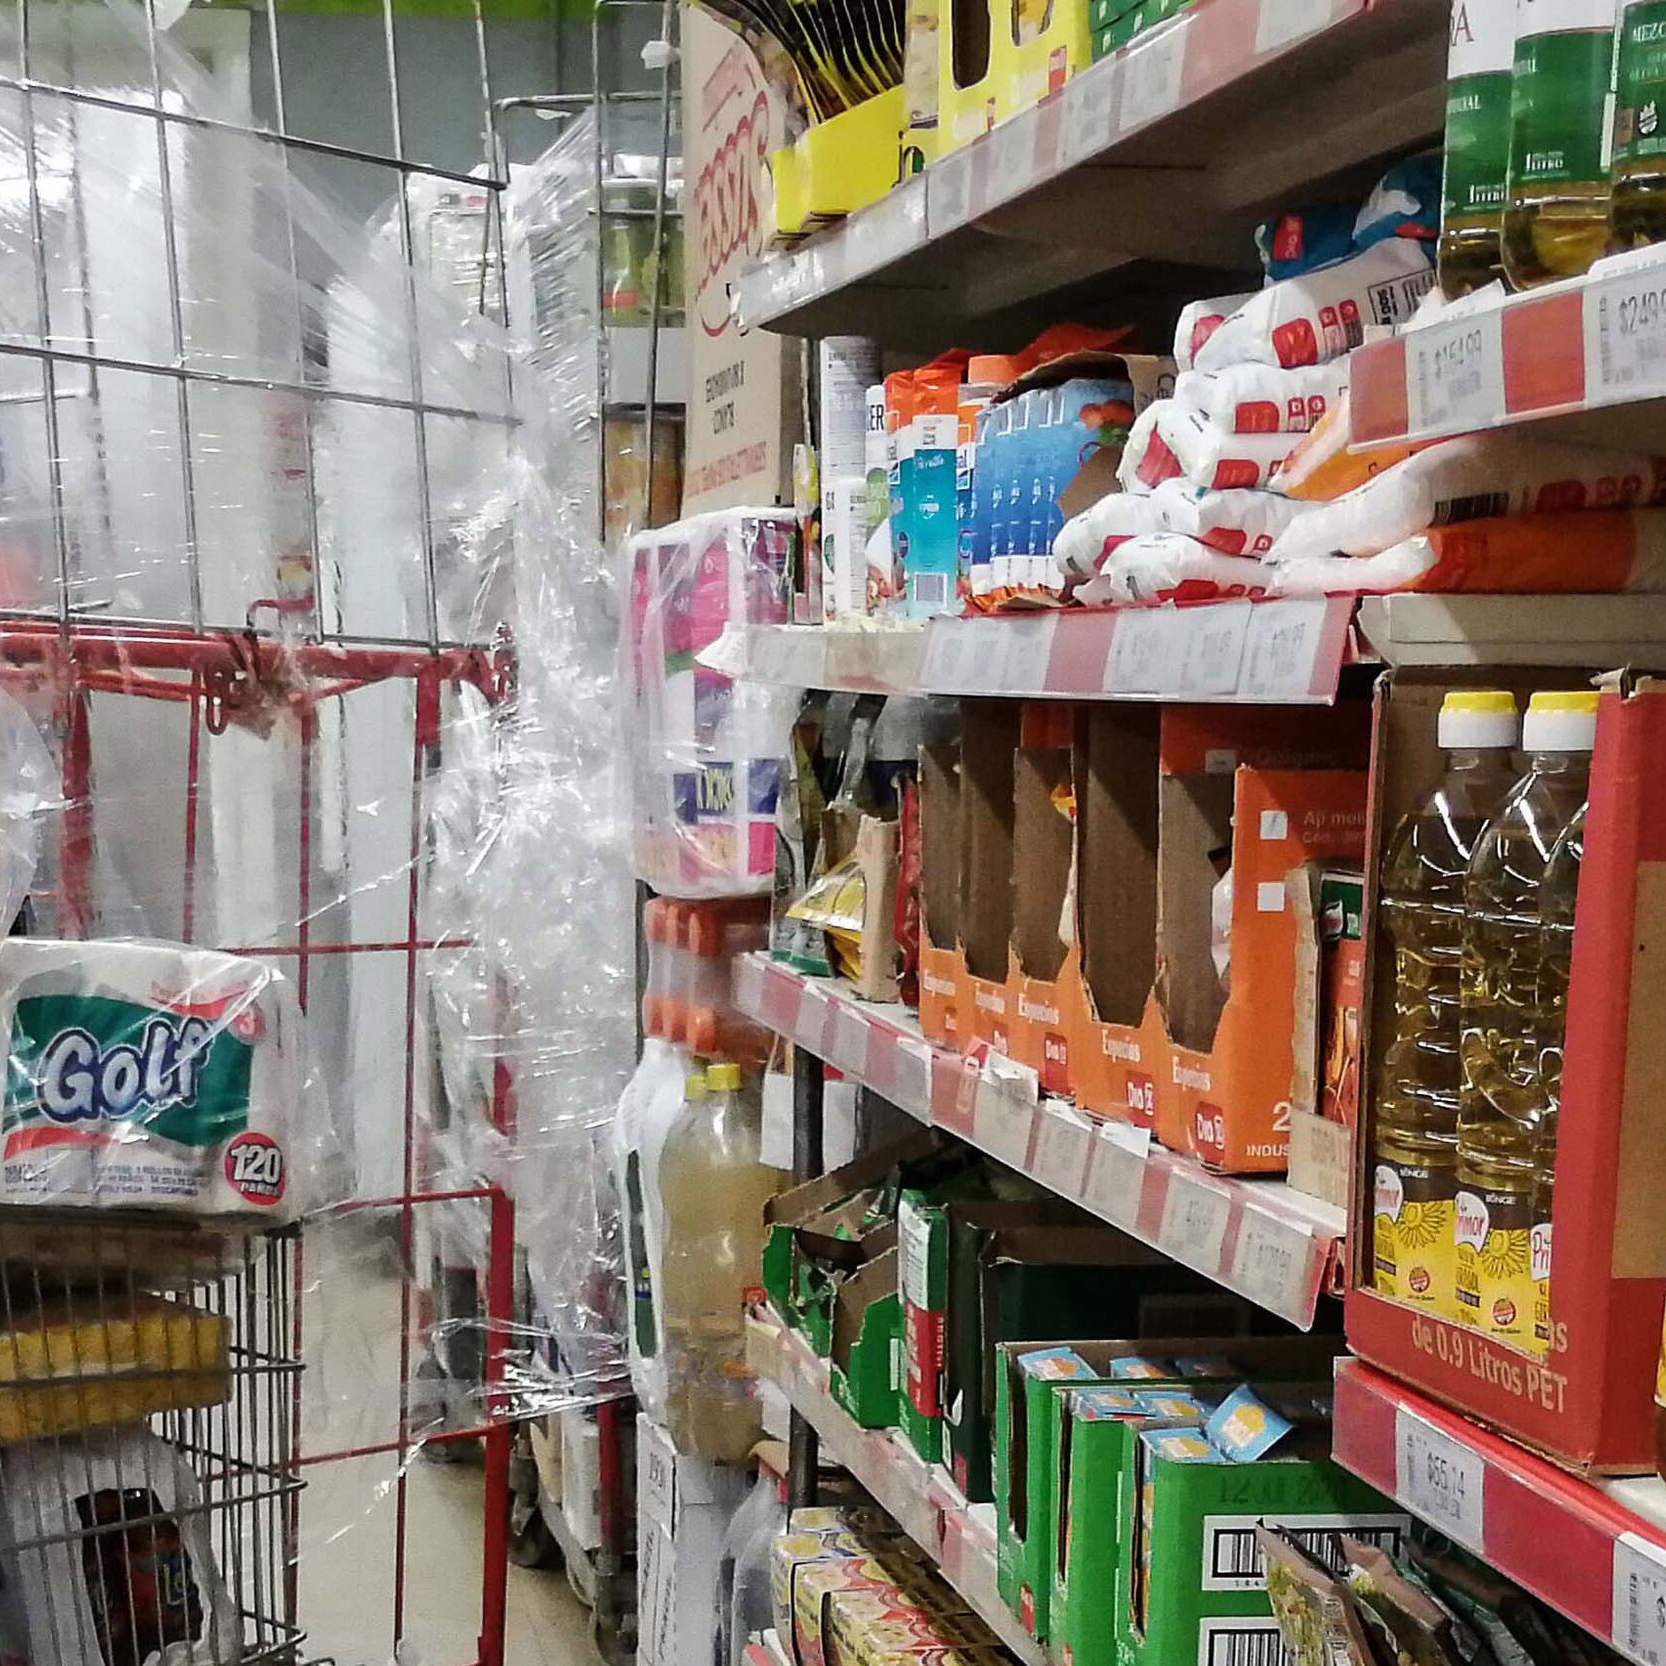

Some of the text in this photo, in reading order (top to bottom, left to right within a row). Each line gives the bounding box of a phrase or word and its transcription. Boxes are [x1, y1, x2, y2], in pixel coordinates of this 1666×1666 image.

[35, 1018, 214, 1124] Golf
[232, 1145, 280, 1179] 120
[1469, 1339, 1523, 1397] Litros
[1527, 1365, 1568, 1414] PET
